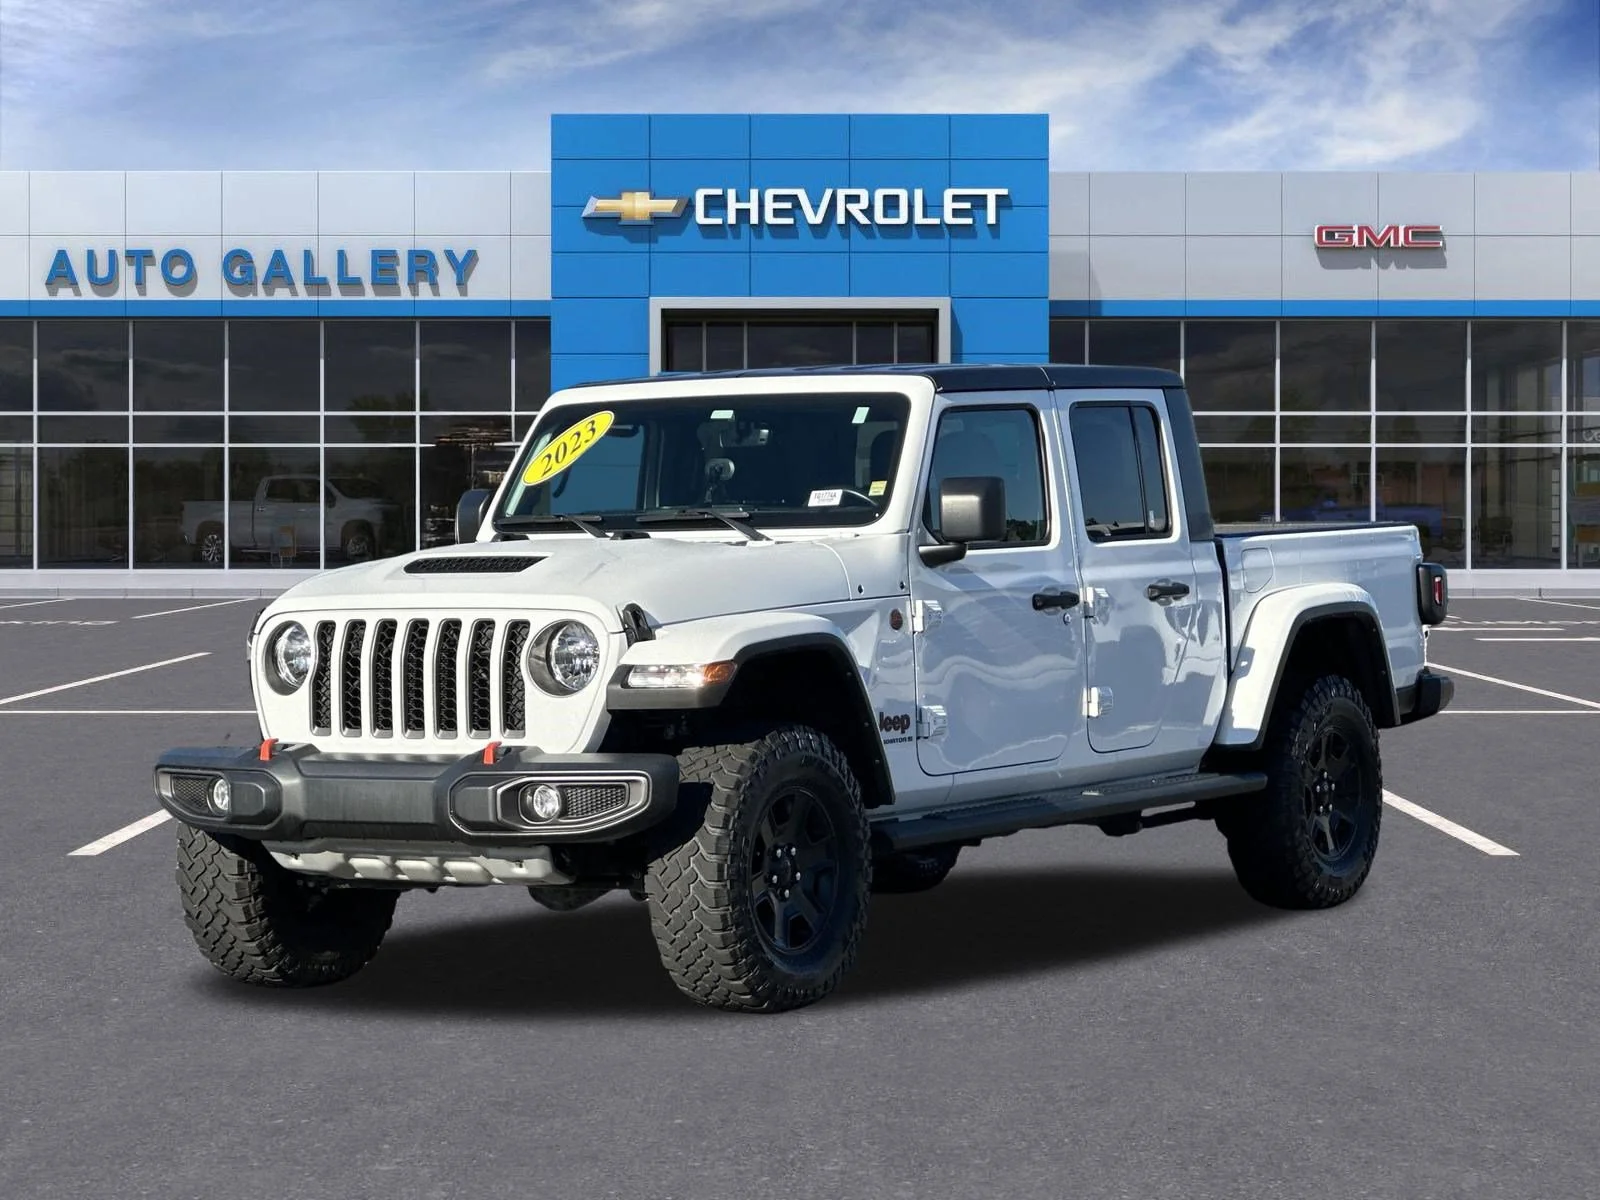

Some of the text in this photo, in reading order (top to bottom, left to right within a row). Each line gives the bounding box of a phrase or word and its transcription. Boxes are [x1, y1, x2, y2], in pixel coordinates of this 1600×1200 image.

[694, 188, 1009, 225] CHEVROLET
[1313, 224, 1443, 249] GMC
[45, 248, 478, 286] AUTO GALLERY
[541, 420, 596, 477] 2023
